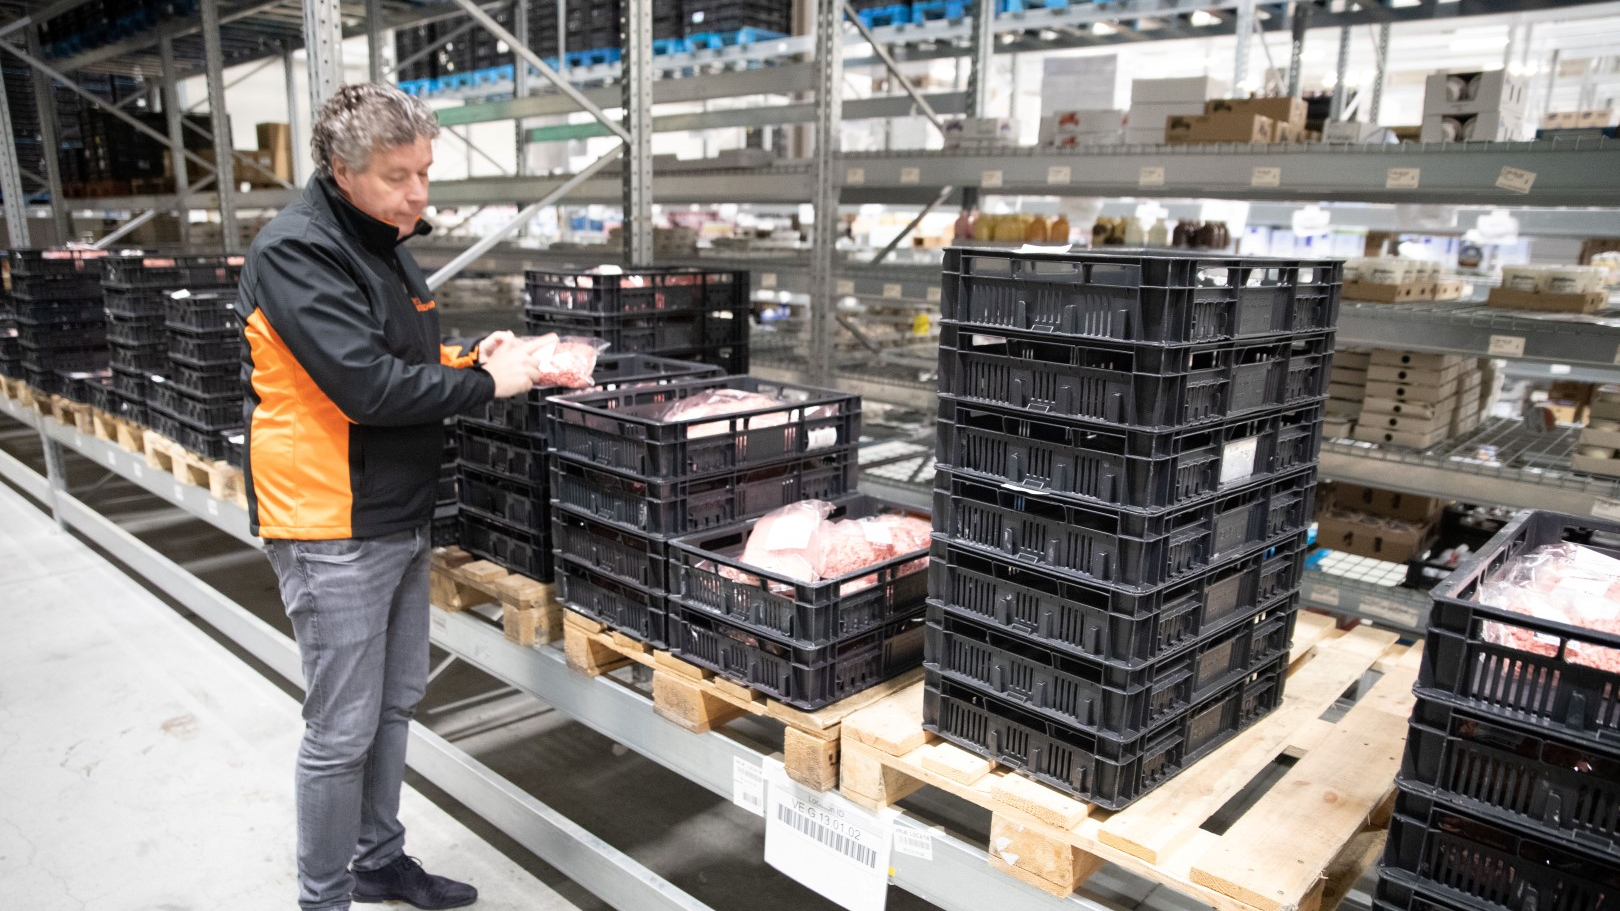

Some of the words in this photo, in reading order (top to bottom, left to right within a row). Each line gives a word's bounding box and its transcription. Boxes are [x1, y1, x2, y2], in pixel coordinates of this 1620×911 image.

[808, 794, 835, 813] Locon
[836, 809, 845, 818] ID
[848, 826, 861, 841] 02
